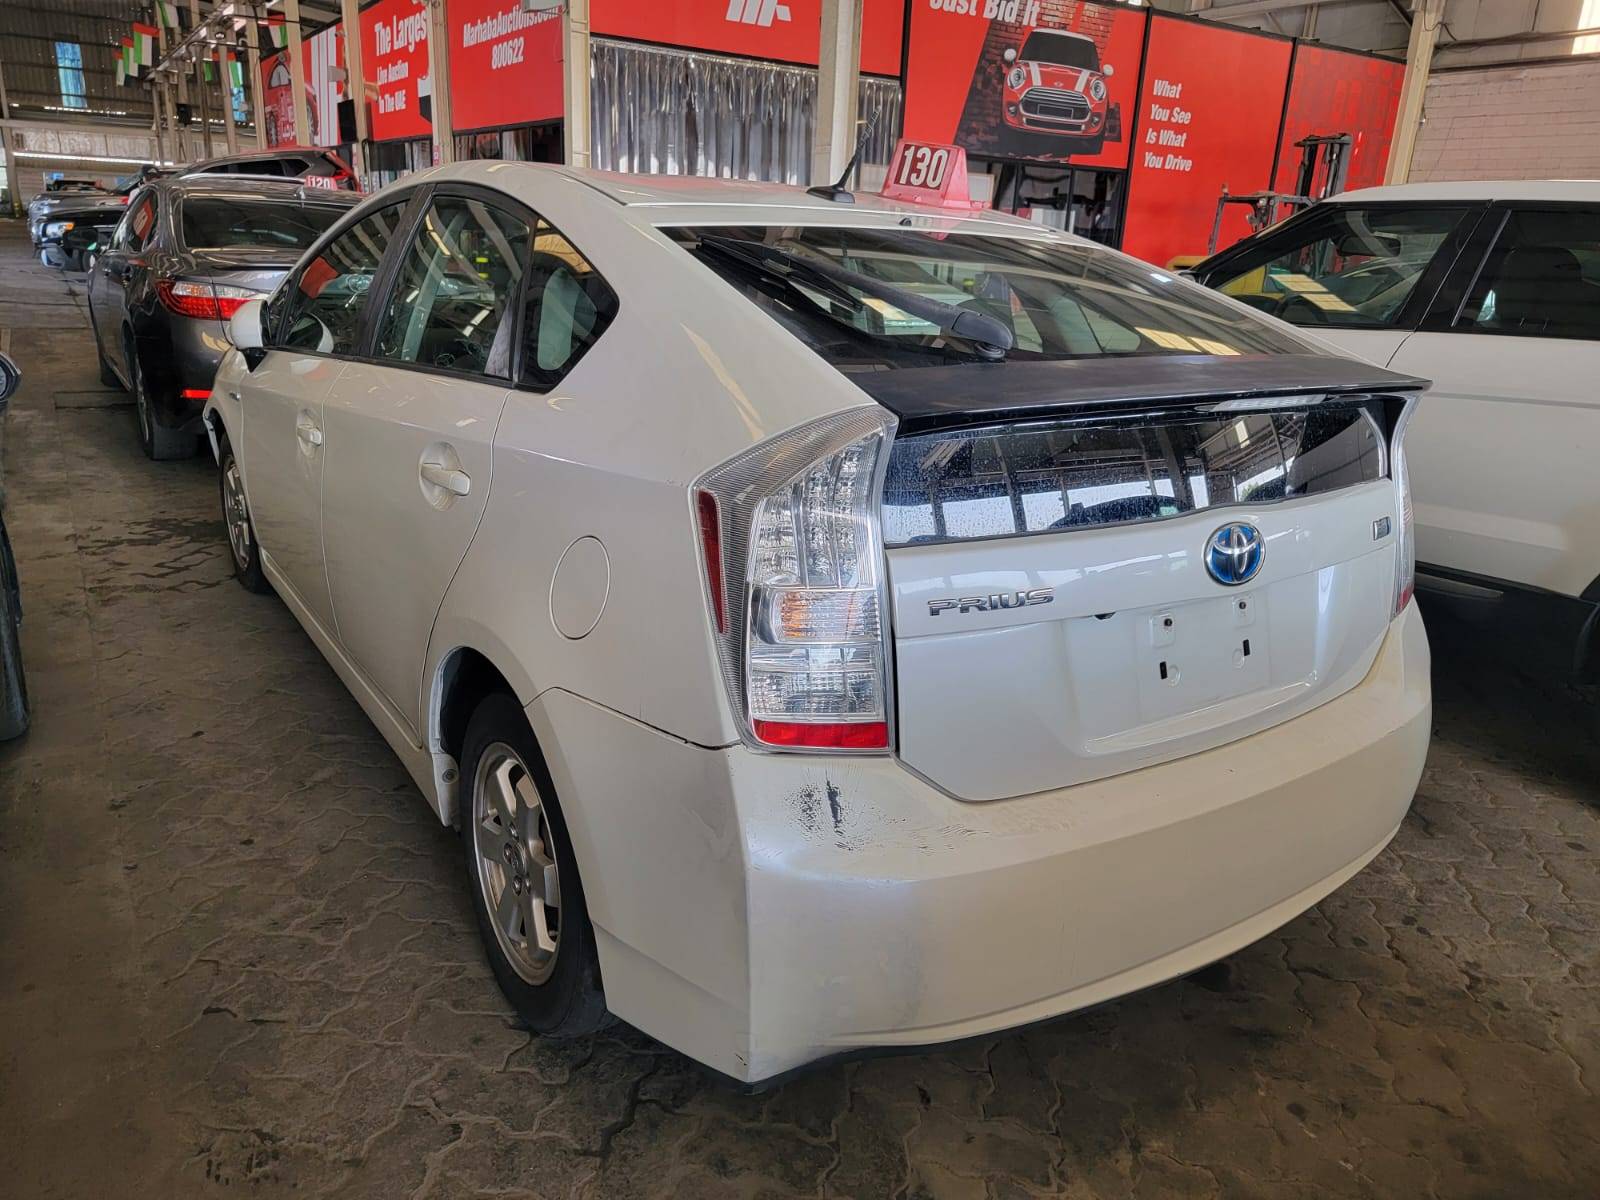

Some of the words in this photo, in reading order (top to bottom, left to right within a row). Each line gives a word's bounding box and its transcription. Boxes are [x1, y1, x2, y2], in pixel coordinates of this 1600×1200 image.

[983, 0, 1020, 22] Bid
[1022, 0, 1040, 27] It
[374, 21, 391, 56] The
[393, 10, 428, 53] Larges
[492, 36, 524, 70] 800622
[1153, 79, 1182, 99] What
[384, 93, 395, 113] The
[1150, 104, 1170, 121] You
[1170, 106, 1192, 124] See
[1145, 128, 1157, 144] Is
[1159, 129, 1187, 147] What
[899, 145, 948, 188] 130
[1144, 151, 1163, 168] You
[1164, 153, 1193, 172] Drive
[310, 175, 330, 190] 120
[927, 587, 1054, 616] PRIUS
